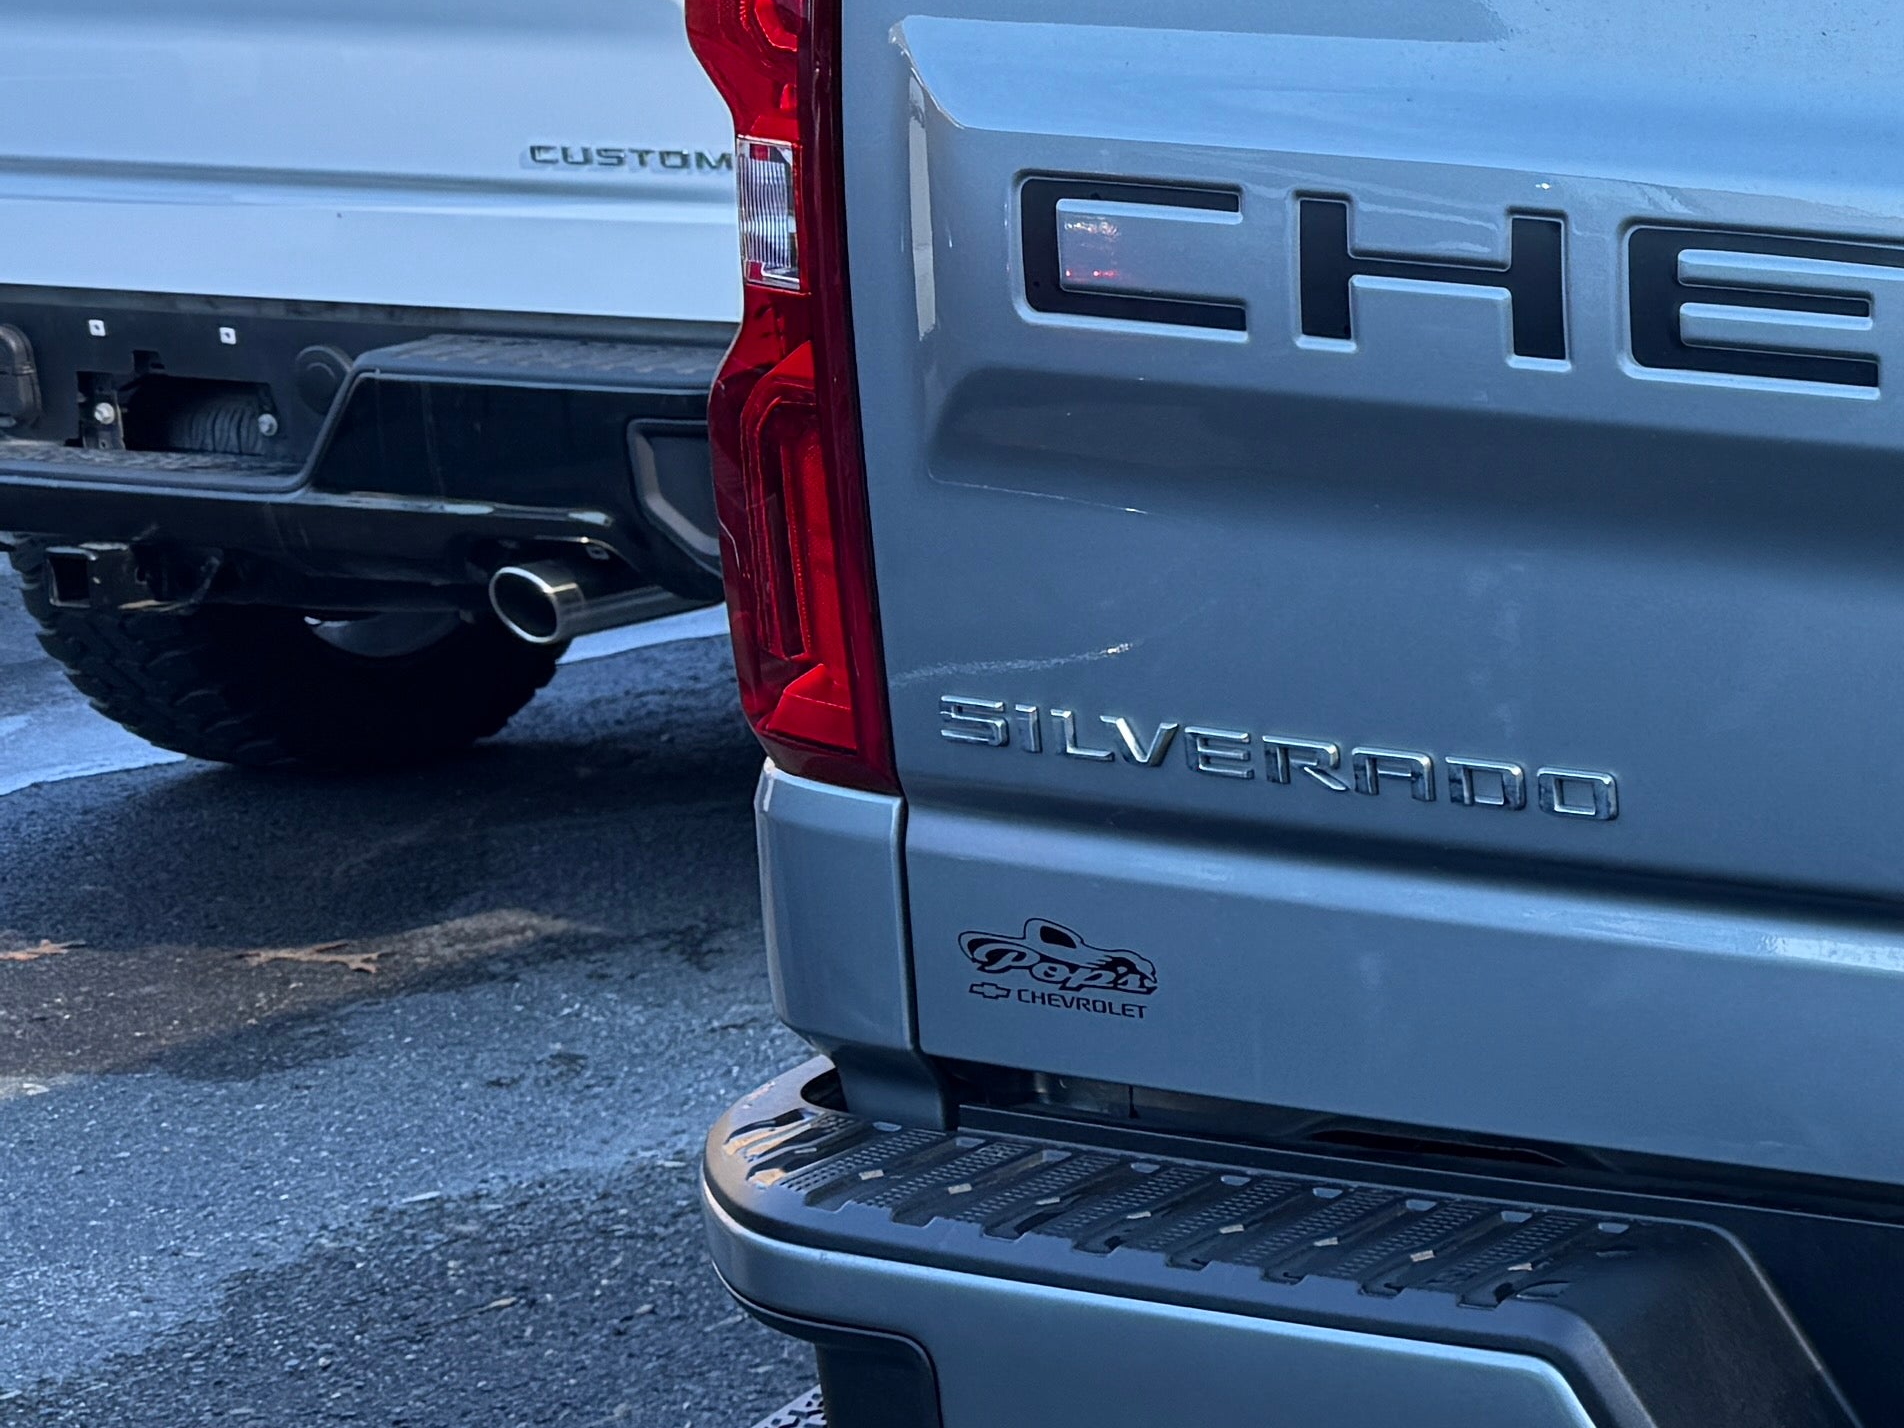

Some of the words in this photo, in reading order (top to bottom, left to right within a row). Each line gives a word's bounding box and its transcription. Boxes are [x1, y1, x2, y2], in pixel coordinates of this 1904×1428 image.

[529, 145, 733, 171] CUSTOM
[939, 694, 1619, 822] SILVERADO
[1016, 988, 1148, 1019] CHEVROLET
